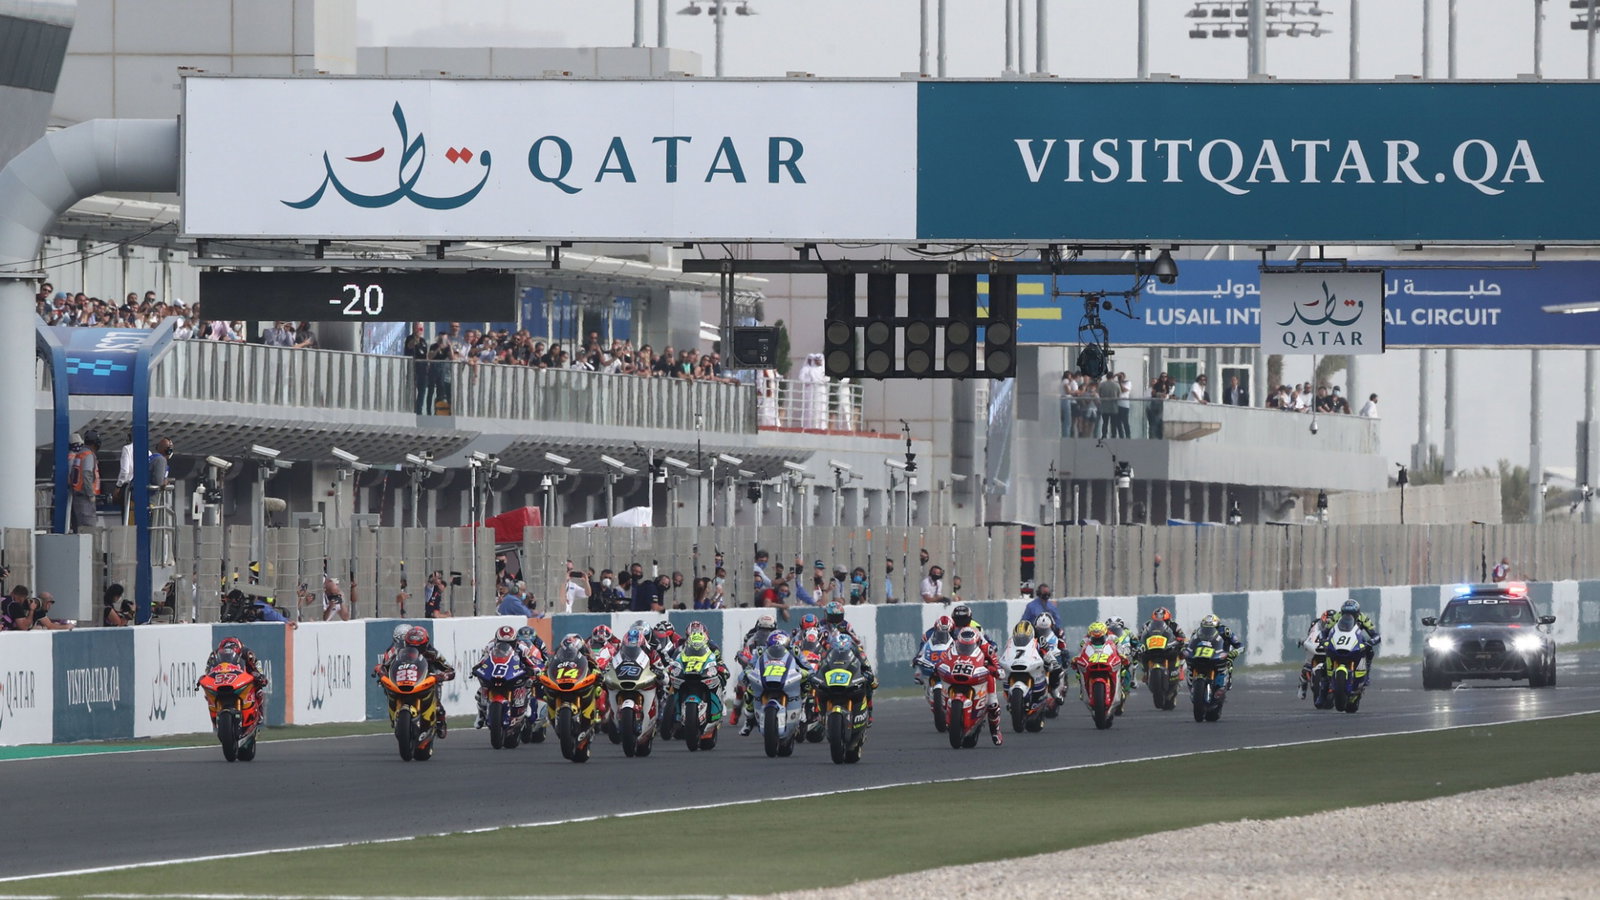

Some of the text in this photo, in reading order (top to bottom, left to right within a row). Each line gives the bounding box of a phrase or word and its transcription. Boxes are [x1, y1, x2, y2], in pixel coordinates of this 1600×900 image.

[528, 134, 807, 194] QATAR
[1014, 138, 1545, 196] VISITQATAR.QA
[328, 284, 384, 316] -20
[1146, 308, 1221, 326] LUSAIL
[1411, 308, 1502, 326] CIRCUIT
[1282, 331, 1364, 348] QATAR
[1336, 635, 1352, 646] 81
[1014, 649, 1026, 660] 7
[1088, 653, 1109, 663] 42
[1194, 646, 1216, 658] 19
[327, 654, 352, 697] QATAR
[492, 664, 508, 677] 6
[556, 668, 579, 679] 14
[762, 665, 787, 677] 12
[952, 664, 974, 676] 96
[169, 661, 197, 706] QATAR
[214, 673, 239, 685] 37
[828, 672, 851, 684] 13
[7, 670, 35, 718] QATAR
[66, 665, 121, 713] VISITQATAR.QA
